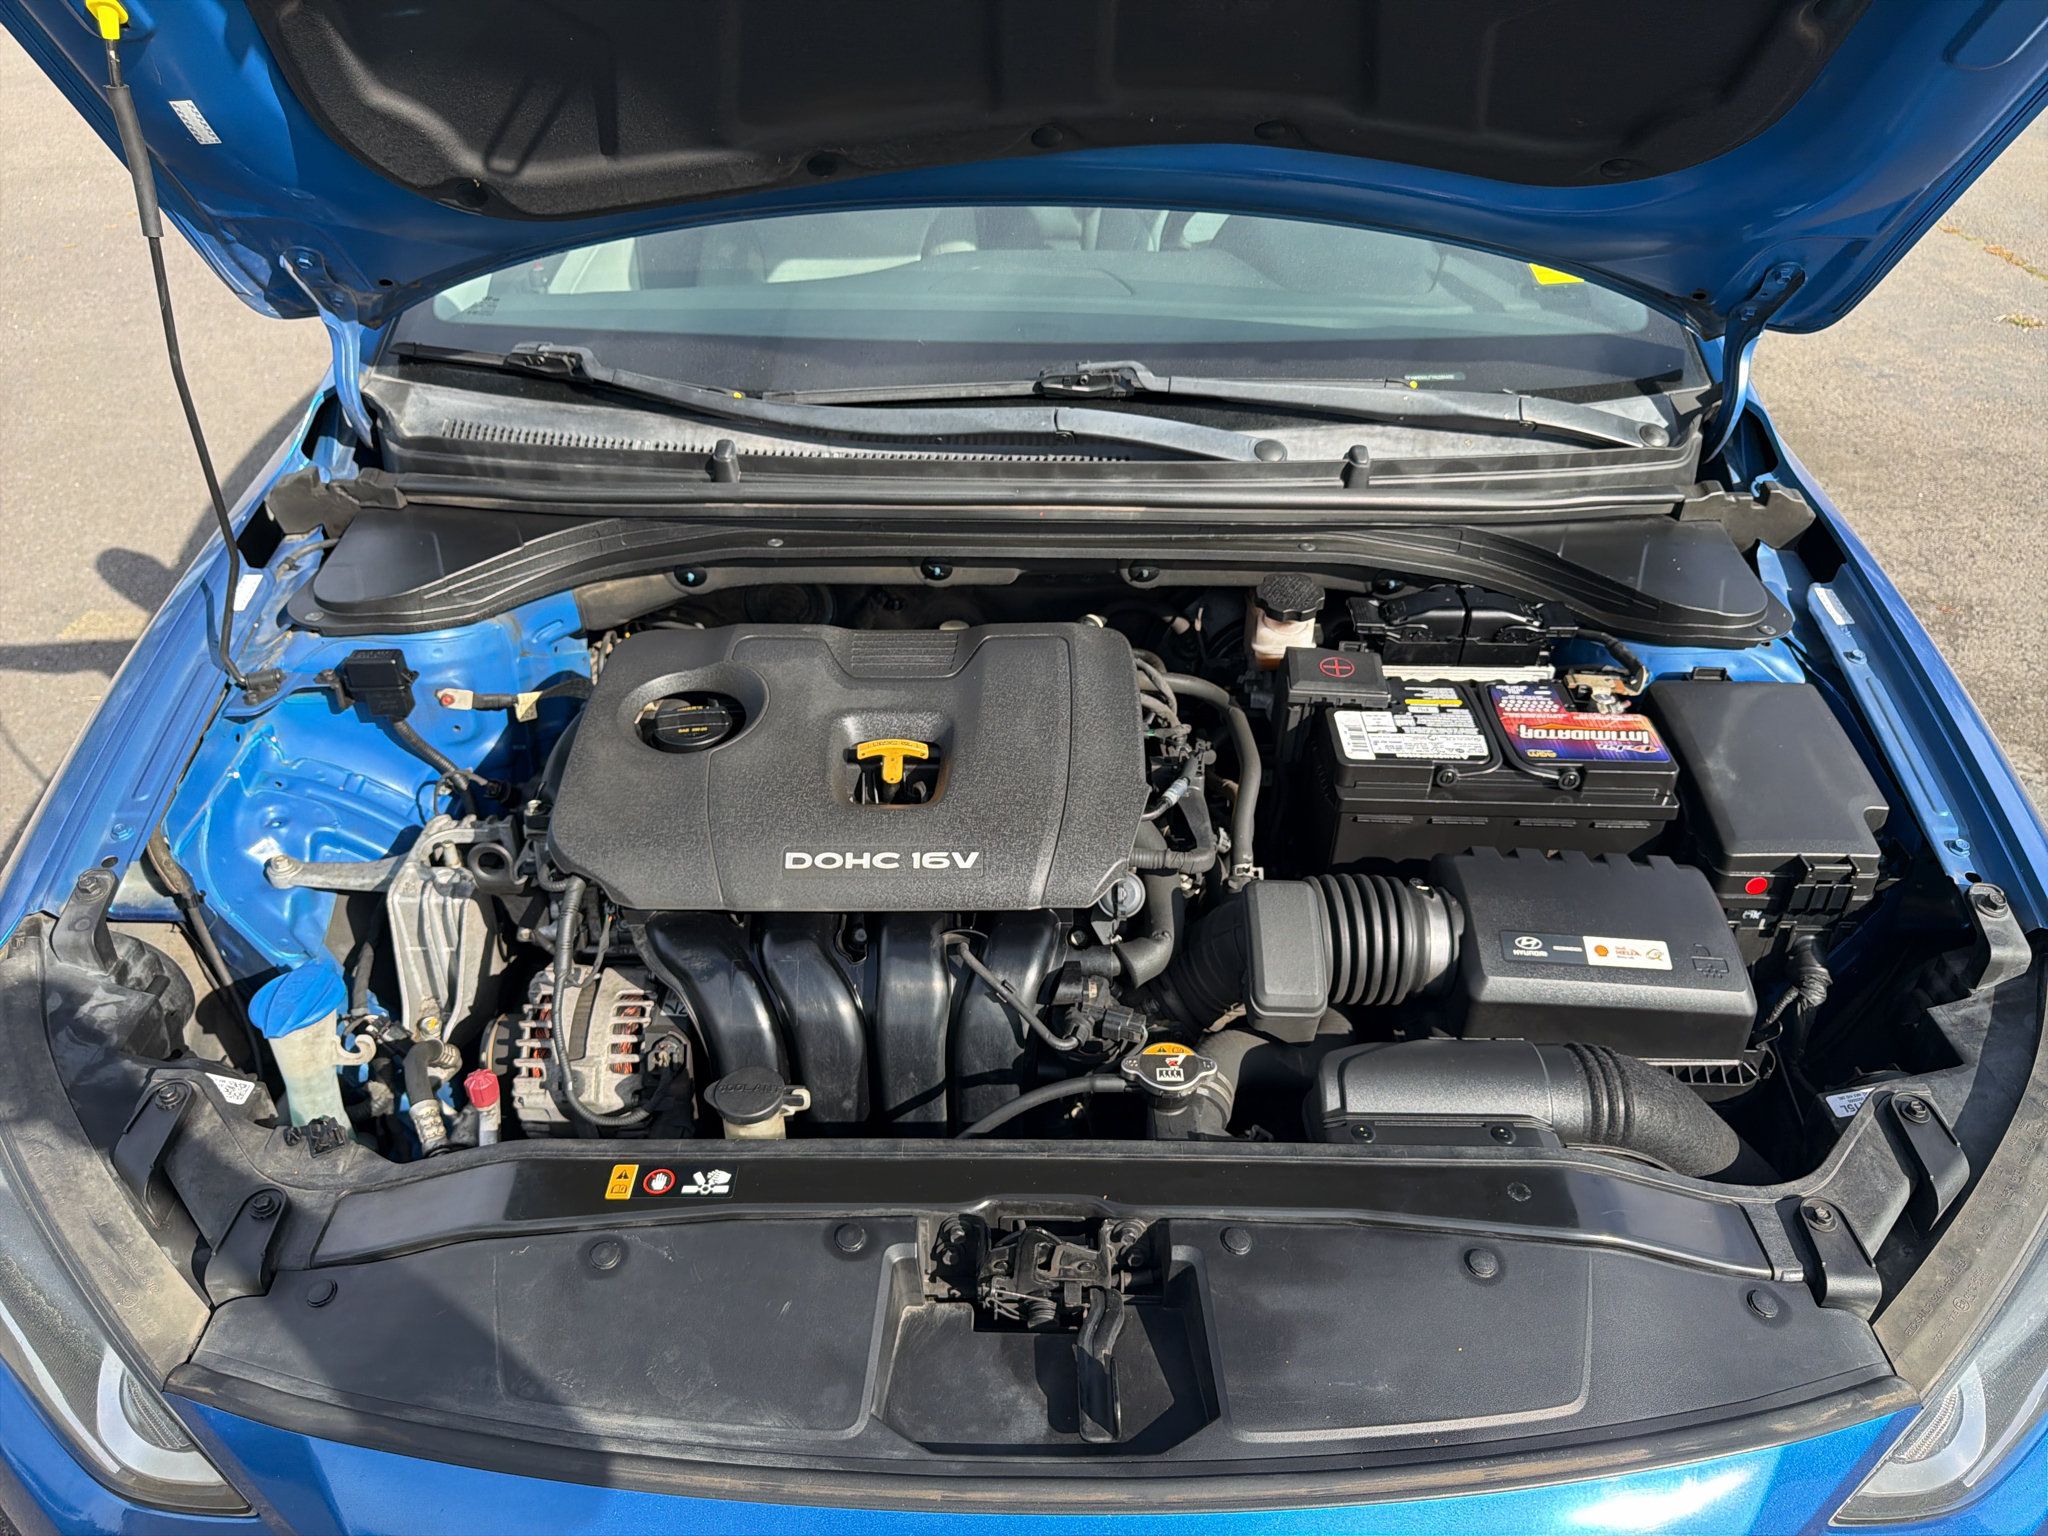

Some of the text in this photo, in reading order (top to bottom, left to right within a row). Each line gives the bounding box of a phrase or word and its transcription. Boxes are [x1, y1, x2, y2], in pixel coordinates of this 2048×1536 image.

[785, 851, 980, 869] DOHC 16V
[1512, 949, 1549, 958] HYUNDAI
